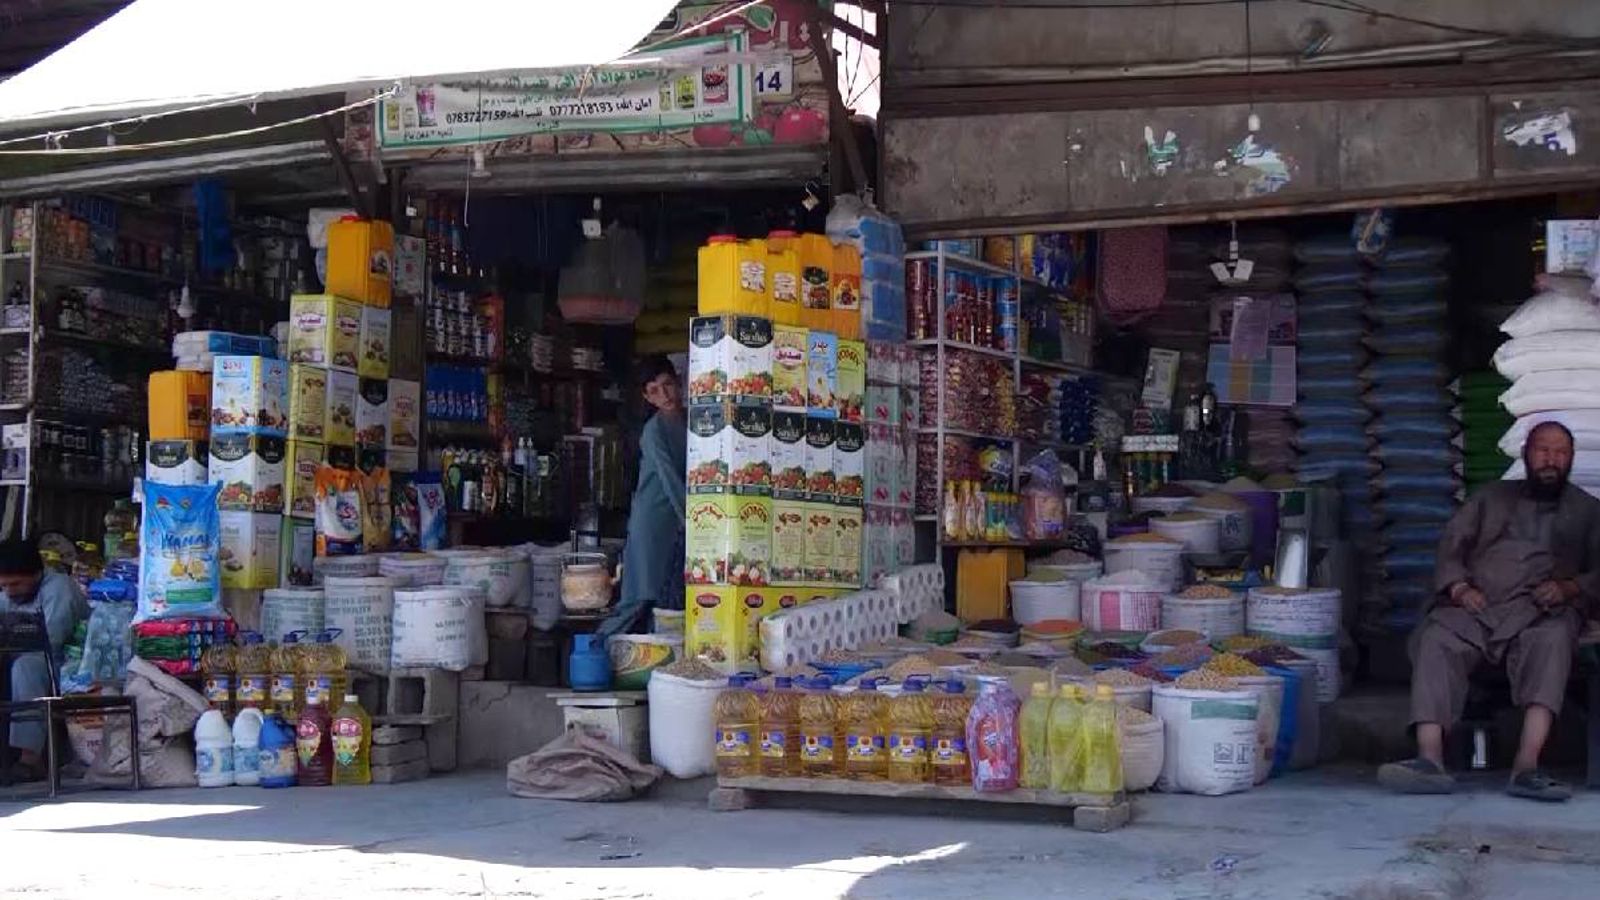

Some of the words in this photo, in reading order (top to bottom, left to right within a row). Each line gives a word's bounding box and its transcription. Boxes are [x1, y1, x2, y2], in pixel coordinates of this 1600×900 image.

[755, 71, 782, 92] 14
[549, 100, 614, 117] 0777218193
[446, 111, 506, 124] 0783727159
